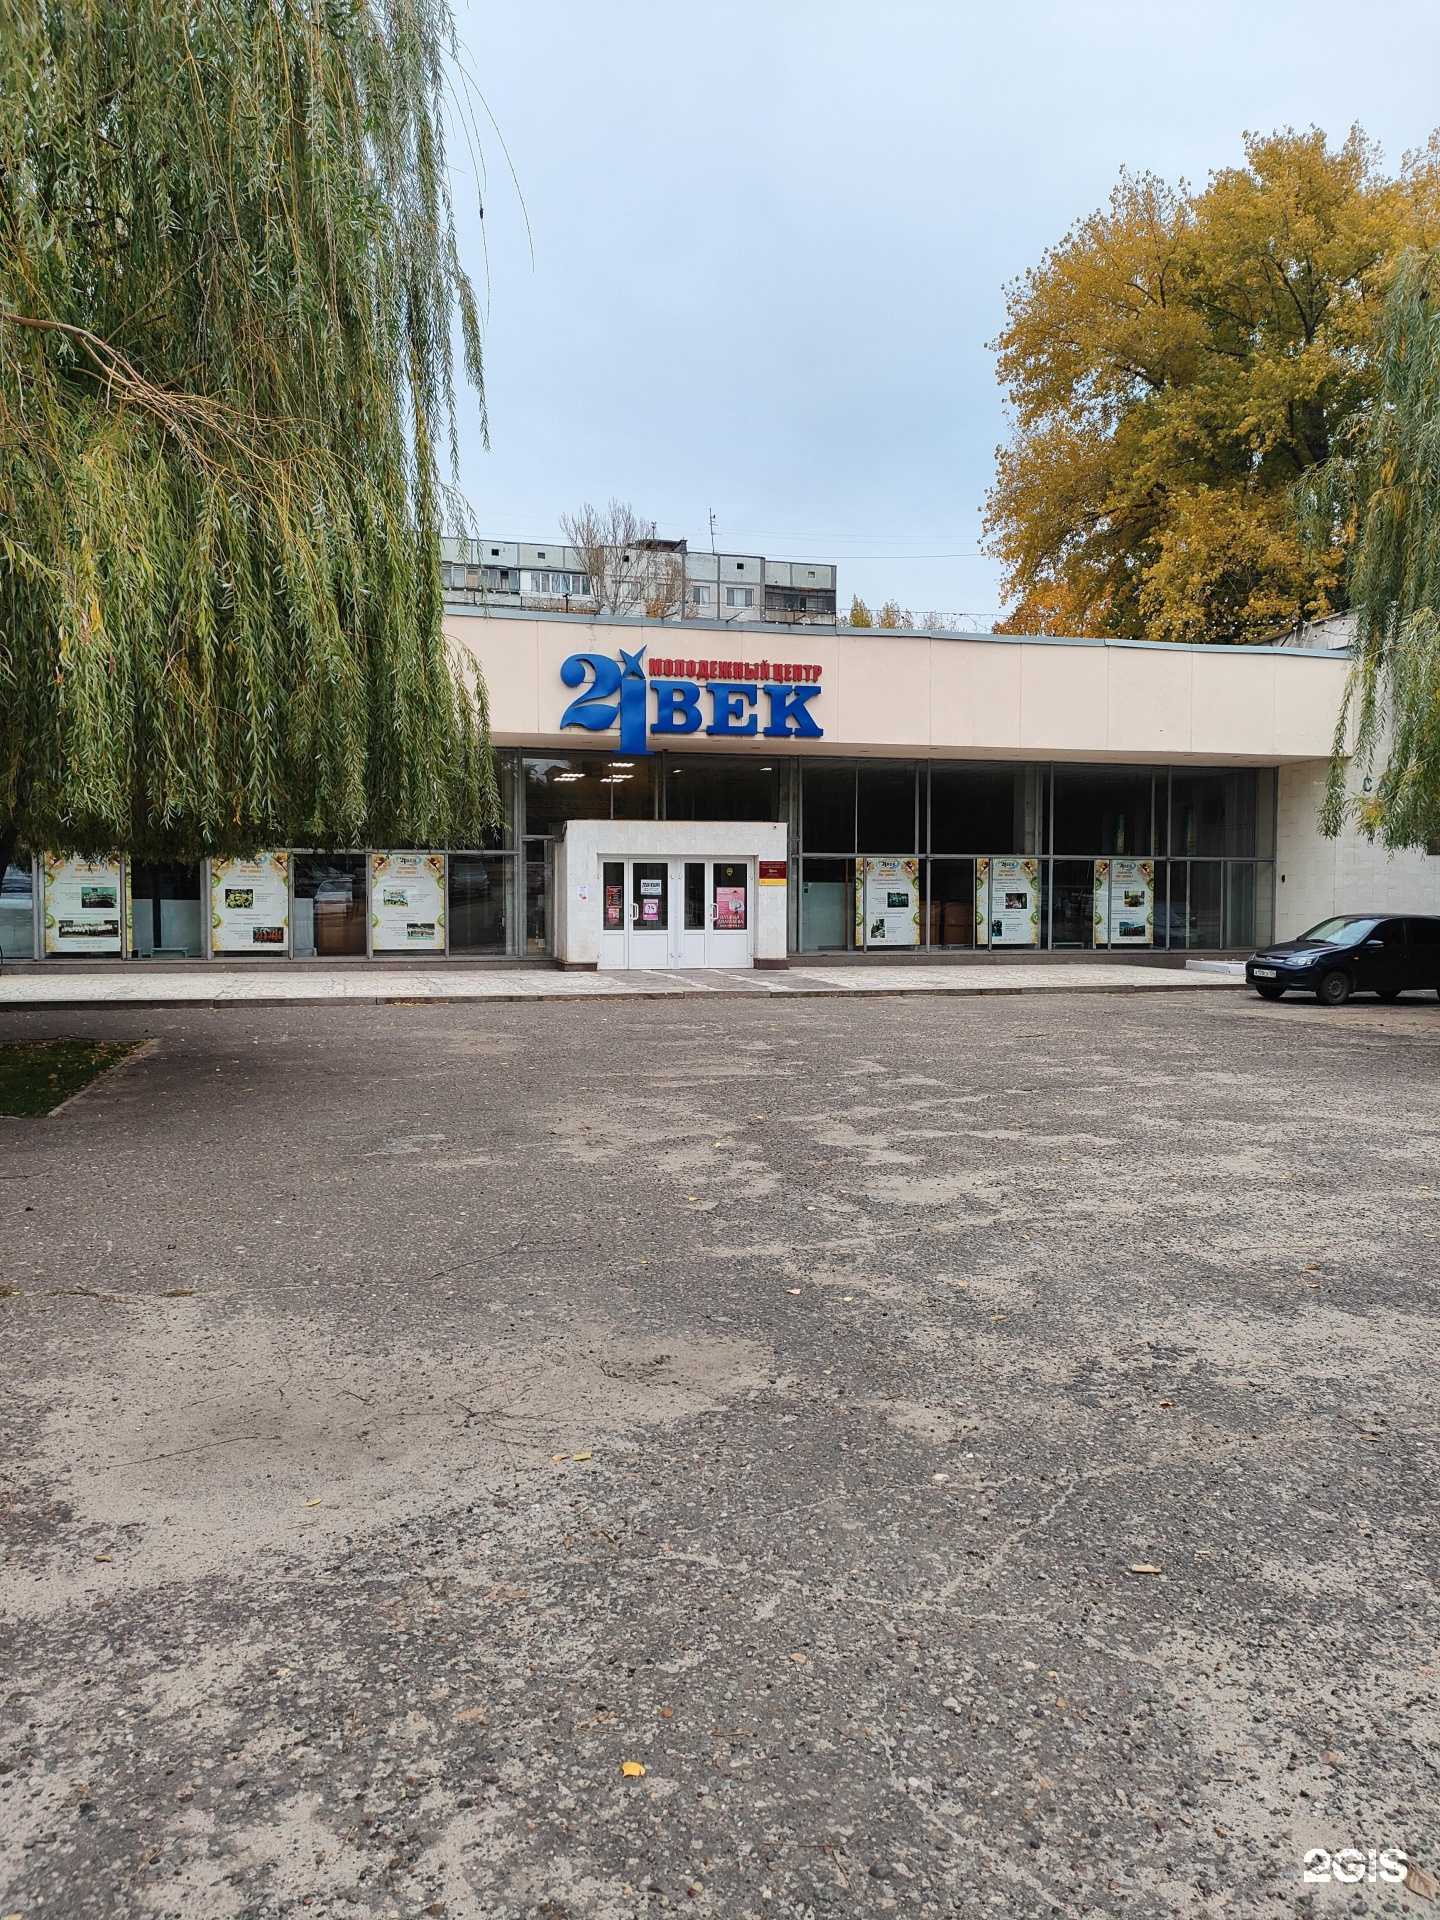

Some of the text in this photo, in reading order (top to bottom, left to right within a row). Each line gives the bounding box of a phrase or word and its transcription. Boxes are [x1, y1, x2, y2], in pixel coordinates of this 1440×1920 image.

[560, 645, 824, 755] 21 ВЕК
[649, 658, 822, 684] МОЛОДЕЖНЫЙ ЦЕНТР
